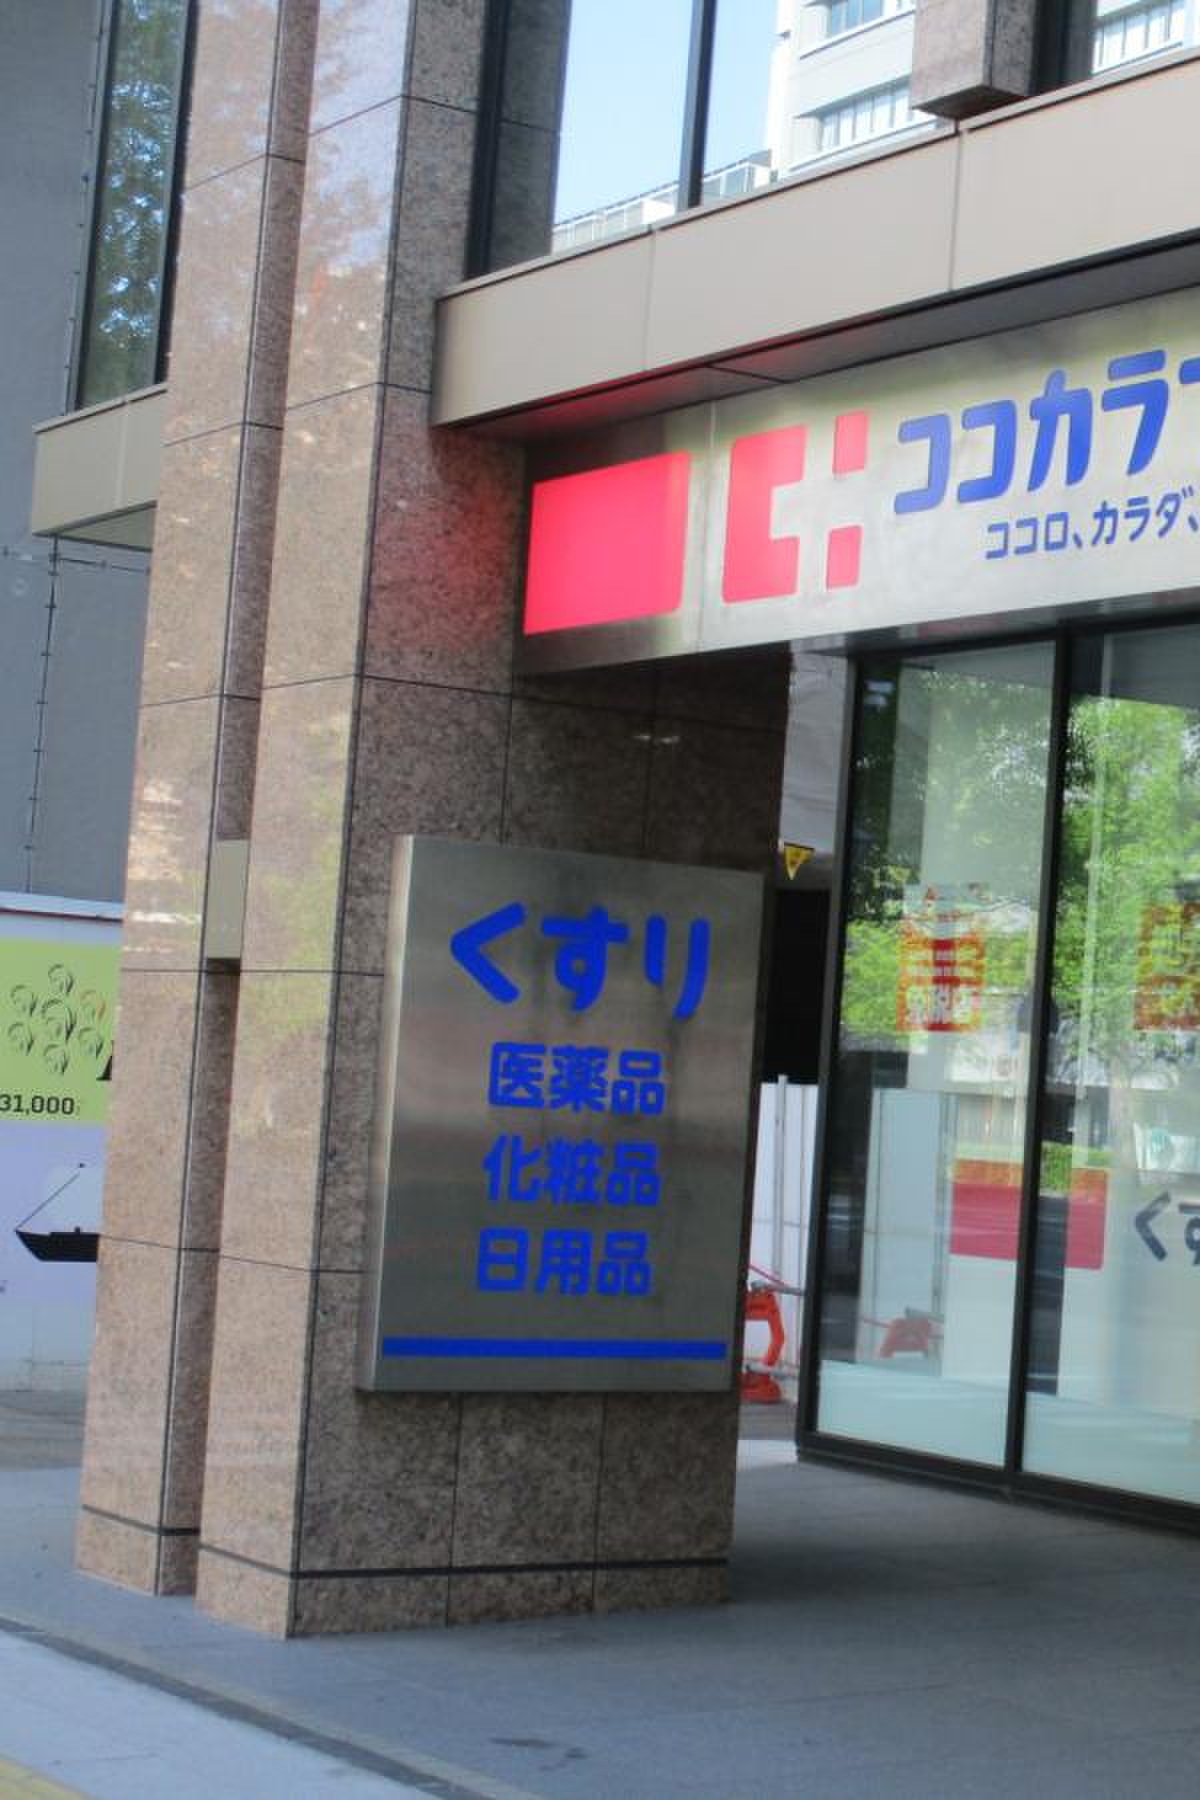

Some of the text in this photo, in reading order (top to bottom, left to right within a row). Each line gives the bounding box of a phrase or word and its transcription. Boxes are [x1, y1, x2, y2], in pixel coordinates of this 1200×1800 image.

[449, 902, 712, 1020] くすり
[487, 1041, 667, 1117] 医薬品
[481, 1132, 664, 1208] 化粧品
[473, 1225, 656, 1298] 日用品
